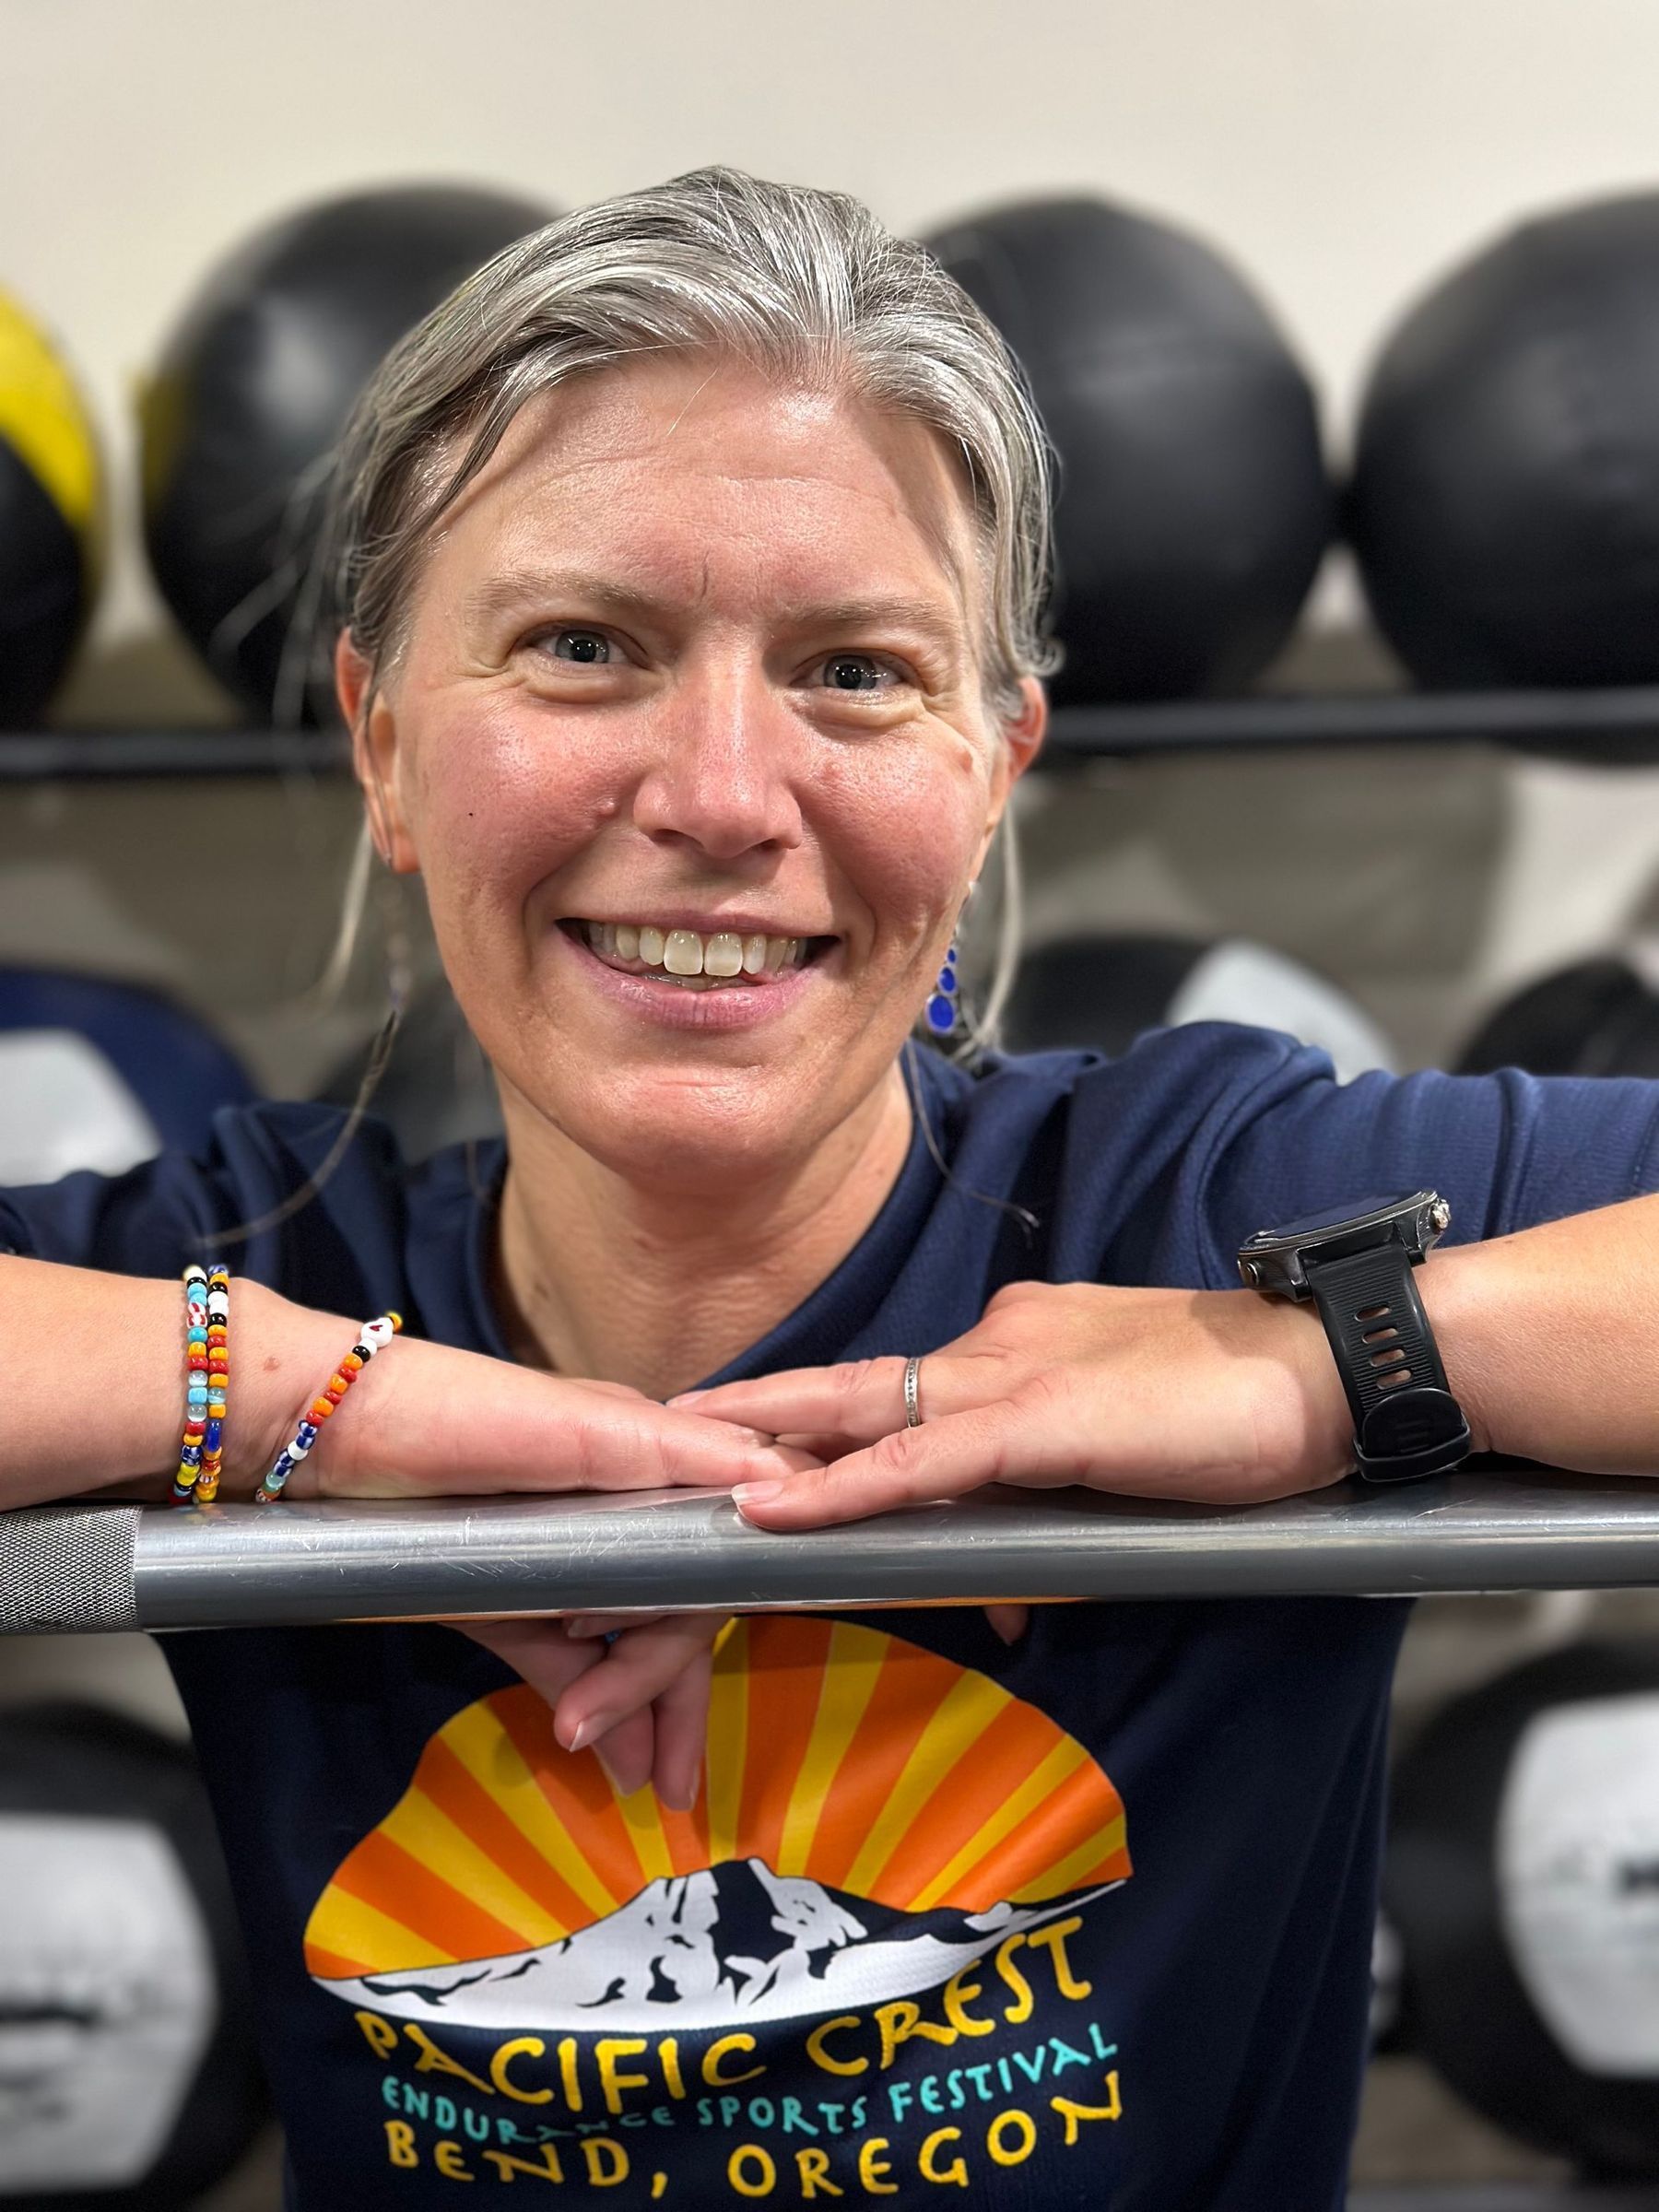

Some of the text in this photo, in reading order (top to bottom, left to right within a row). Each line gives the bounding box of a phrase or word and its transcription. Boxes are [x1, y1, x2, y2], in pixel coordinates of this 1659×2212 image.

[355, 1916, 1091, 2114] PACIFIC CREST
[697, 2095, 867, 2135] SPORTS
[888, 2023, 1118, 2123] FESTIVAL
[384, 2070, 1123, 2199] BEND, OREGON
